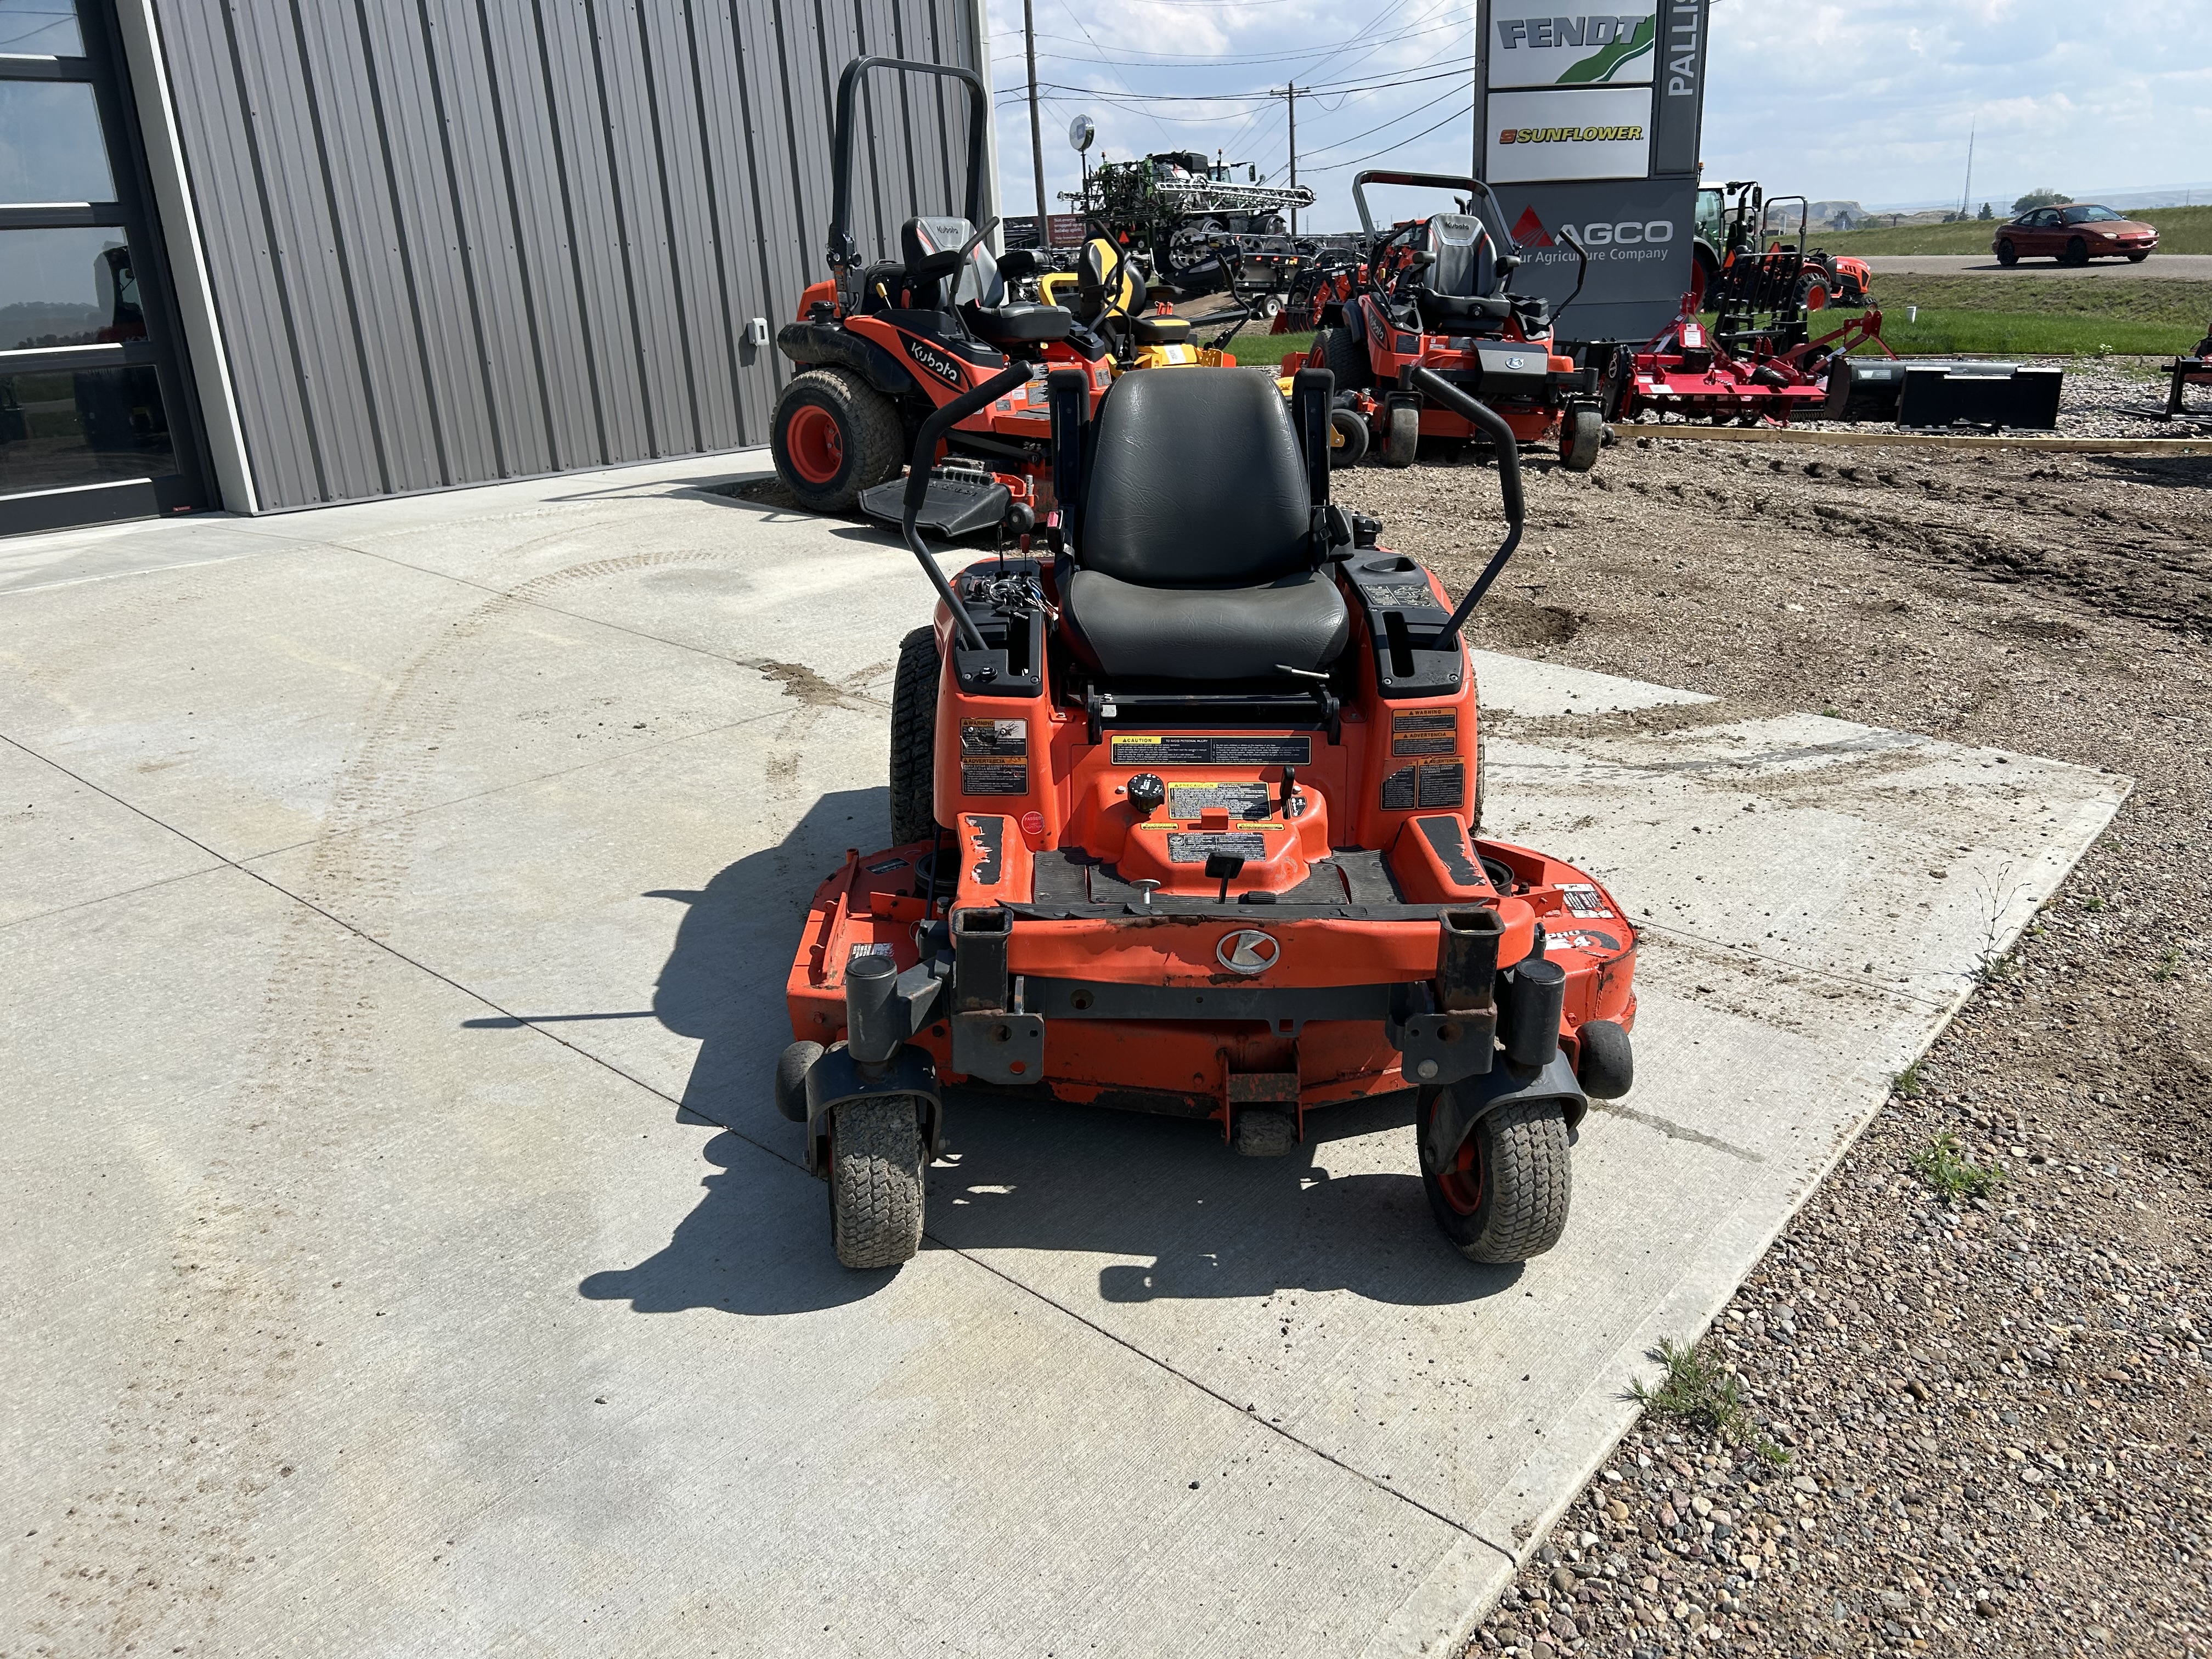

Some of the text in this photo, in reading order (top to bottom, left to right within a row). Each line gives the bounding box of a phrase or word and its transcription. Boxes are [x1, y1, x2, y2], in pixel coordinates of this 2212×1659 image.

[1497, 16, 1647, 49] FENDT
[1668, 0, 1698, 95] PALLI
[1517, 126, 1641, 143] SUNFLOWER
[1445, 222, 1469, 230] Kubota
[1554, 221, 1673, 246] AGCO
[1535, 250, 1605, 265] Agriculure
[1610, 249, 1668, 262] Company
[911, 342, 957, 381] Kubota
